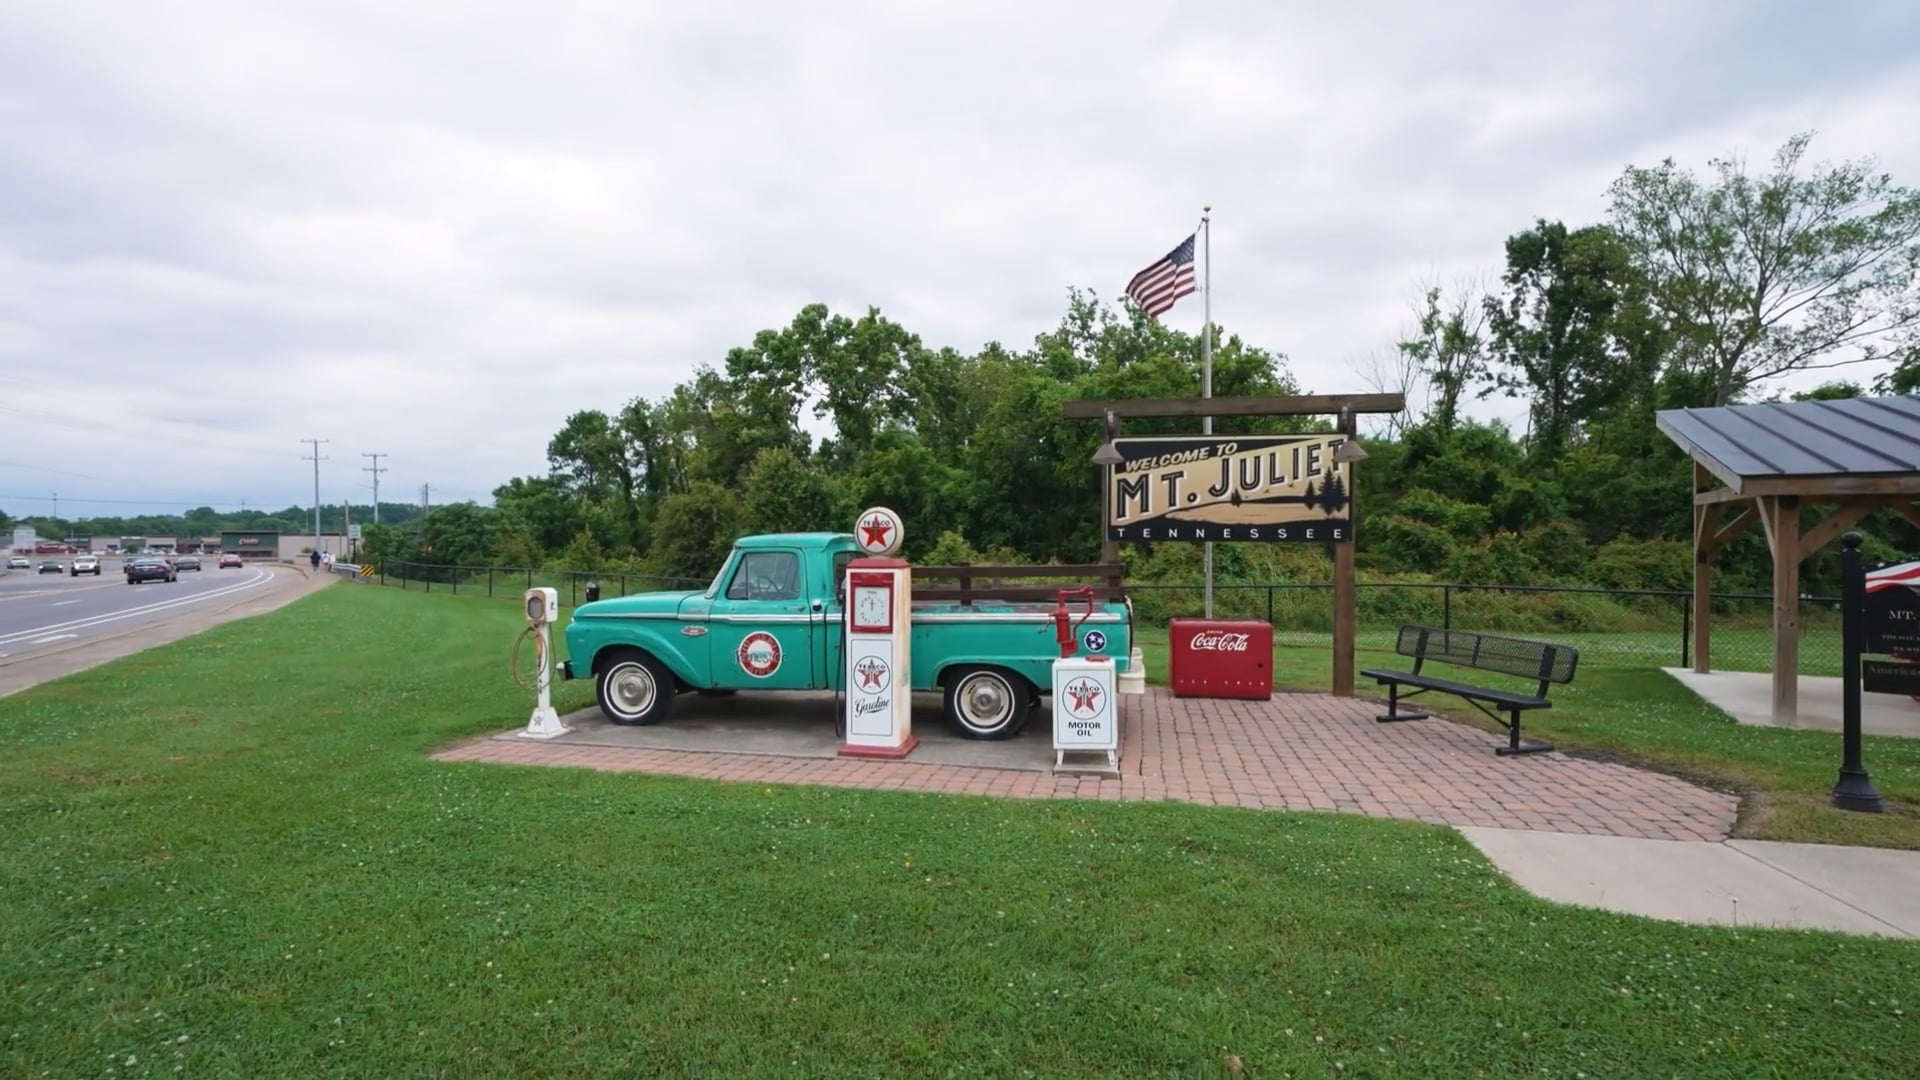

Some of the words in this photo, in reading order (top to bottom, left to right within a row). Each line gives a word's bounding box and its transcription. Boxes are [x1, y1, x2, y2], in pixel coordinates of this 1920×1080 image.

[1125, 447, 1210, 473] WELCOME
[1216, 442, 1238, 457] TO
[1116, 471, 1198, 520] MT.
[1208, 438, 1345, 499] JULIET
[863, 520, 890, 528] TEXACO
[1117, 528, 1342, 539] TENNESSEE
[1190, 632, 1250, 651] Coca-Cola
[854, 696, 890, 718] Gasoline
[1068, 721, 1101, 729] MOTOR
[1076, 729, 1092, 737] OIL
